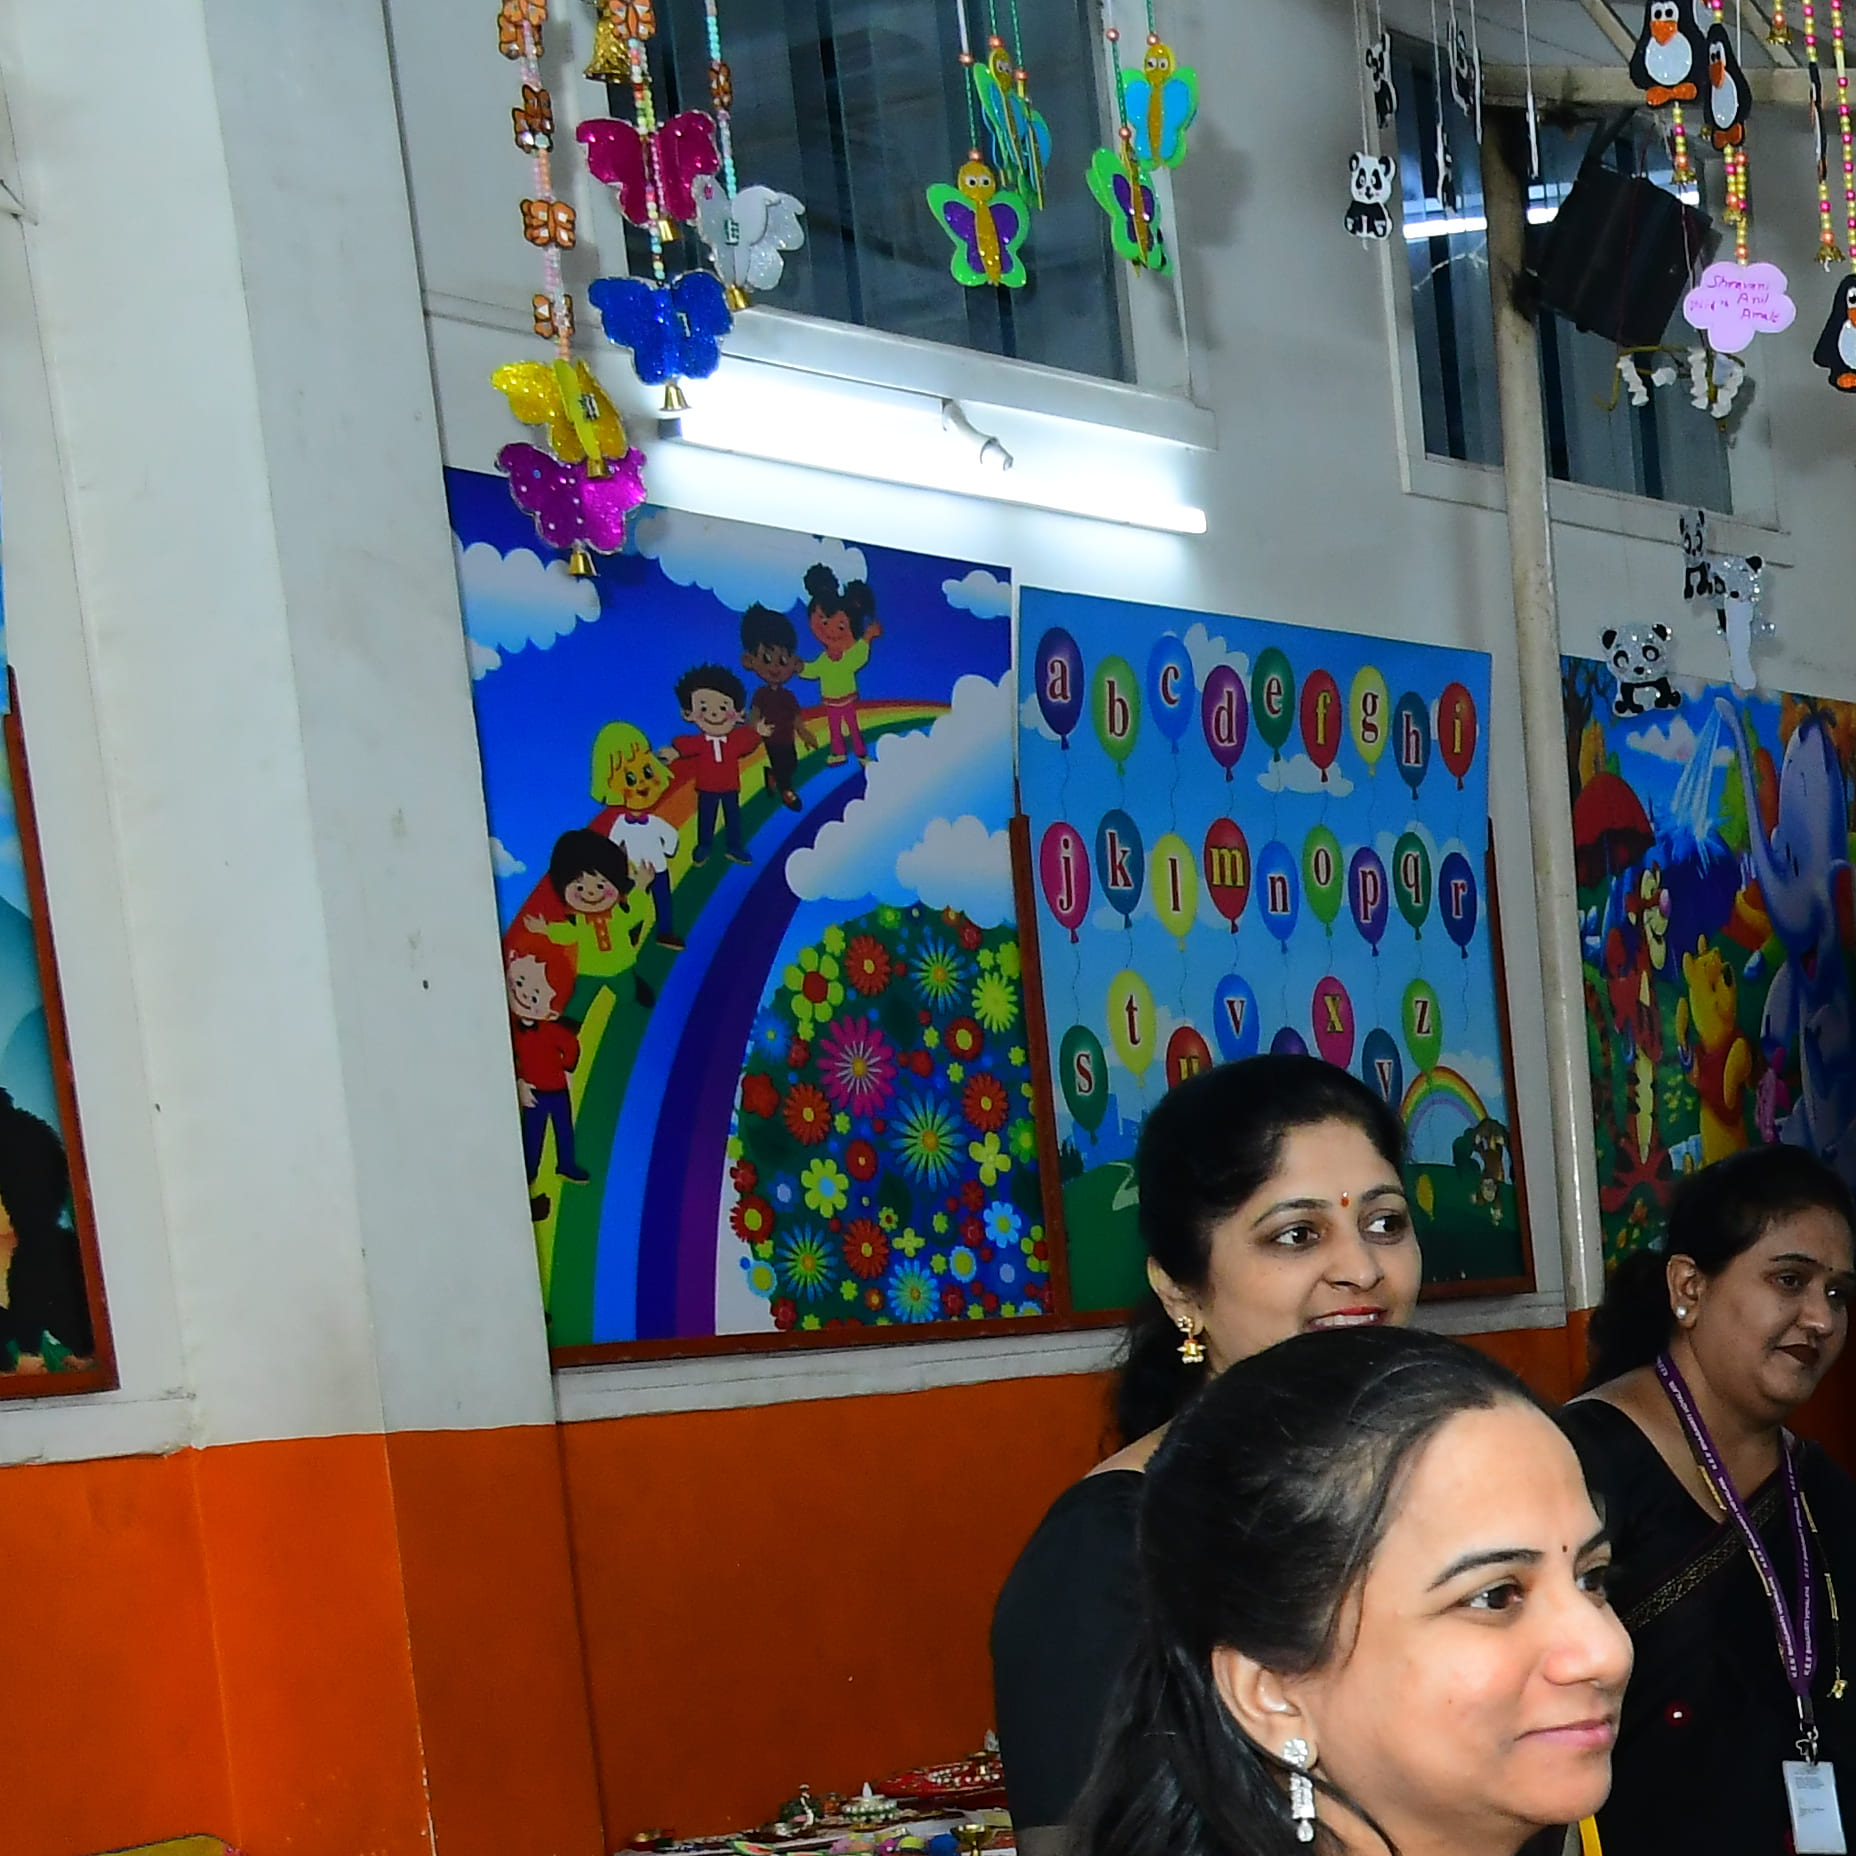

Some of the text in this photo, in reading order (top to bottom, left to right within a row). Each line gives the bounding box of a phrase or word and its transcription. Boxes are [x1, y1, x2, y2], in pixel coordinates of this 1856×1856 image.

[1048, 660, 1464, 764] a b c d e f g h i
[1058, 832, 1466, 922] j k l m n o p q r
[1077, 1054, 1093, 1093] s
[1125, 996, 1140, 1045] t
[1225, 999, 1246, 1035] v
[1324, 998, 1342, 1033] x
[1415, 1000, 1430, 1034] z
